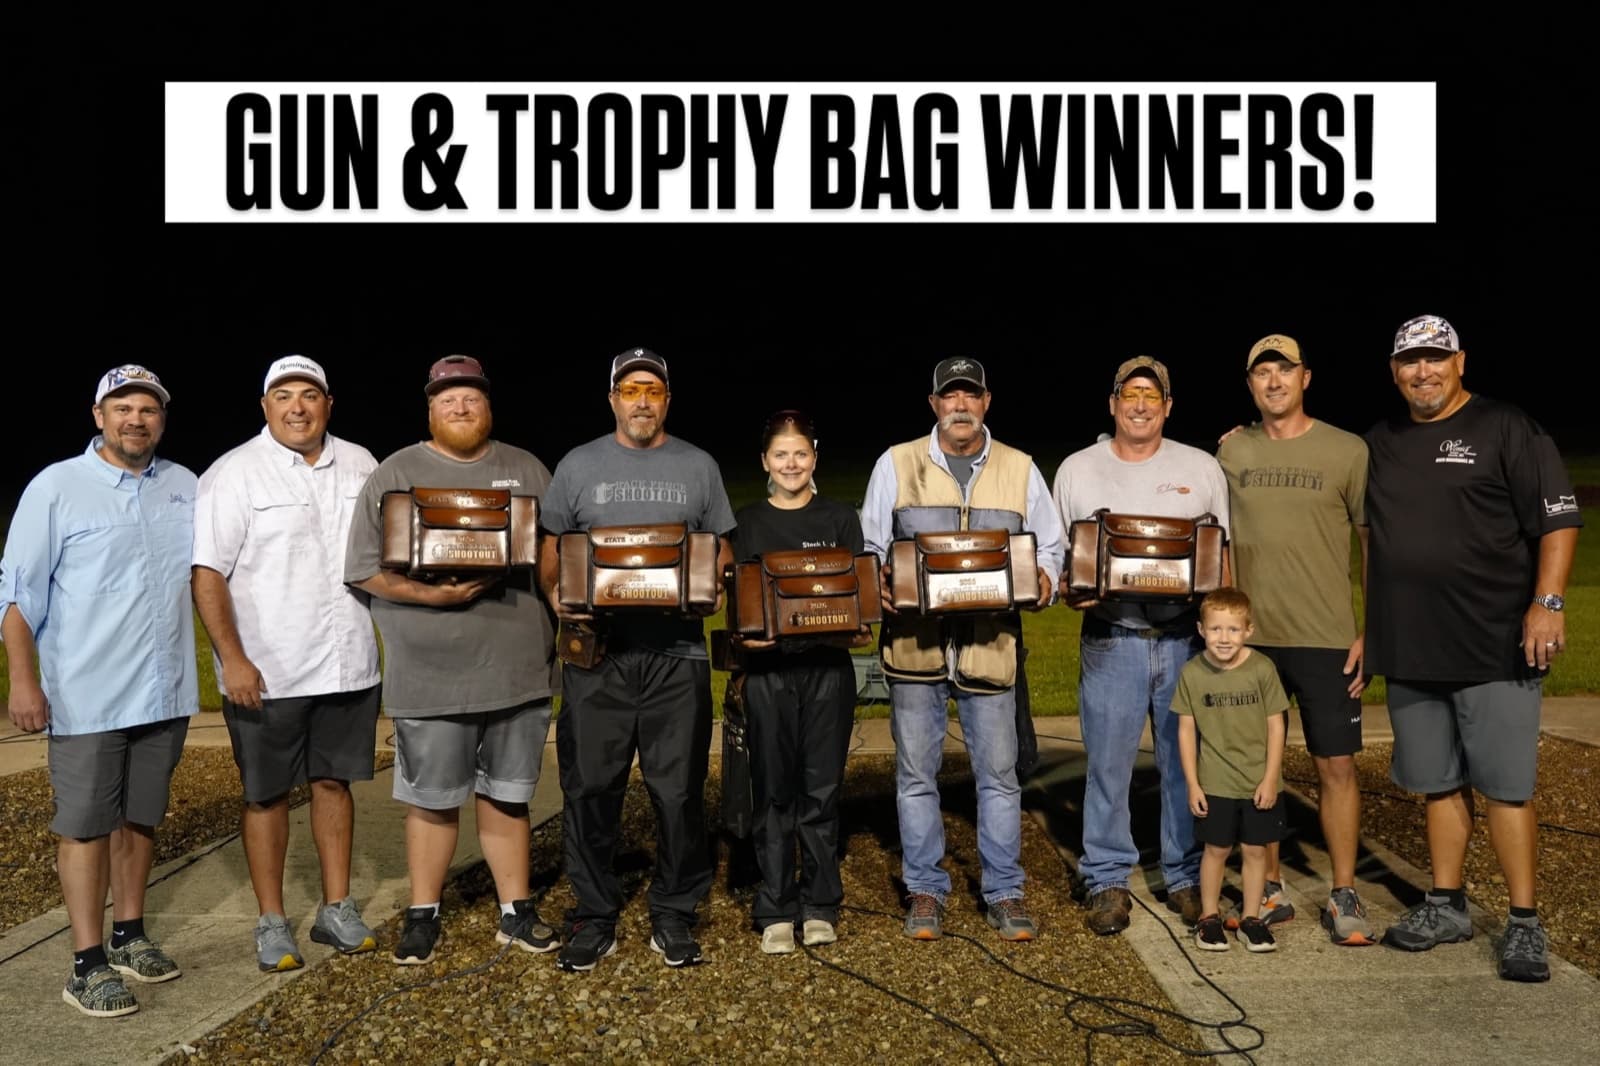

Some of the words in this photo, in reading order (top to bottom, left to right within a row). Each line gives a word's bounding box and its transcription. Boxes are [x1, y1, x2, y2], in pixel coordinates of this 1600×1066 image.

[1253, 472, 1322, 491] SHOOTOUT
[614, 487, 687, 504] SHOOTOUT
[448, 549, 497, 560] SHOOTOUT
[1133, 576, 1180, 587] SHOOTOUT
[620, 588, 669, 600] SHOOTOUT
[804, 613, 849, 626] SHOOTOUT
